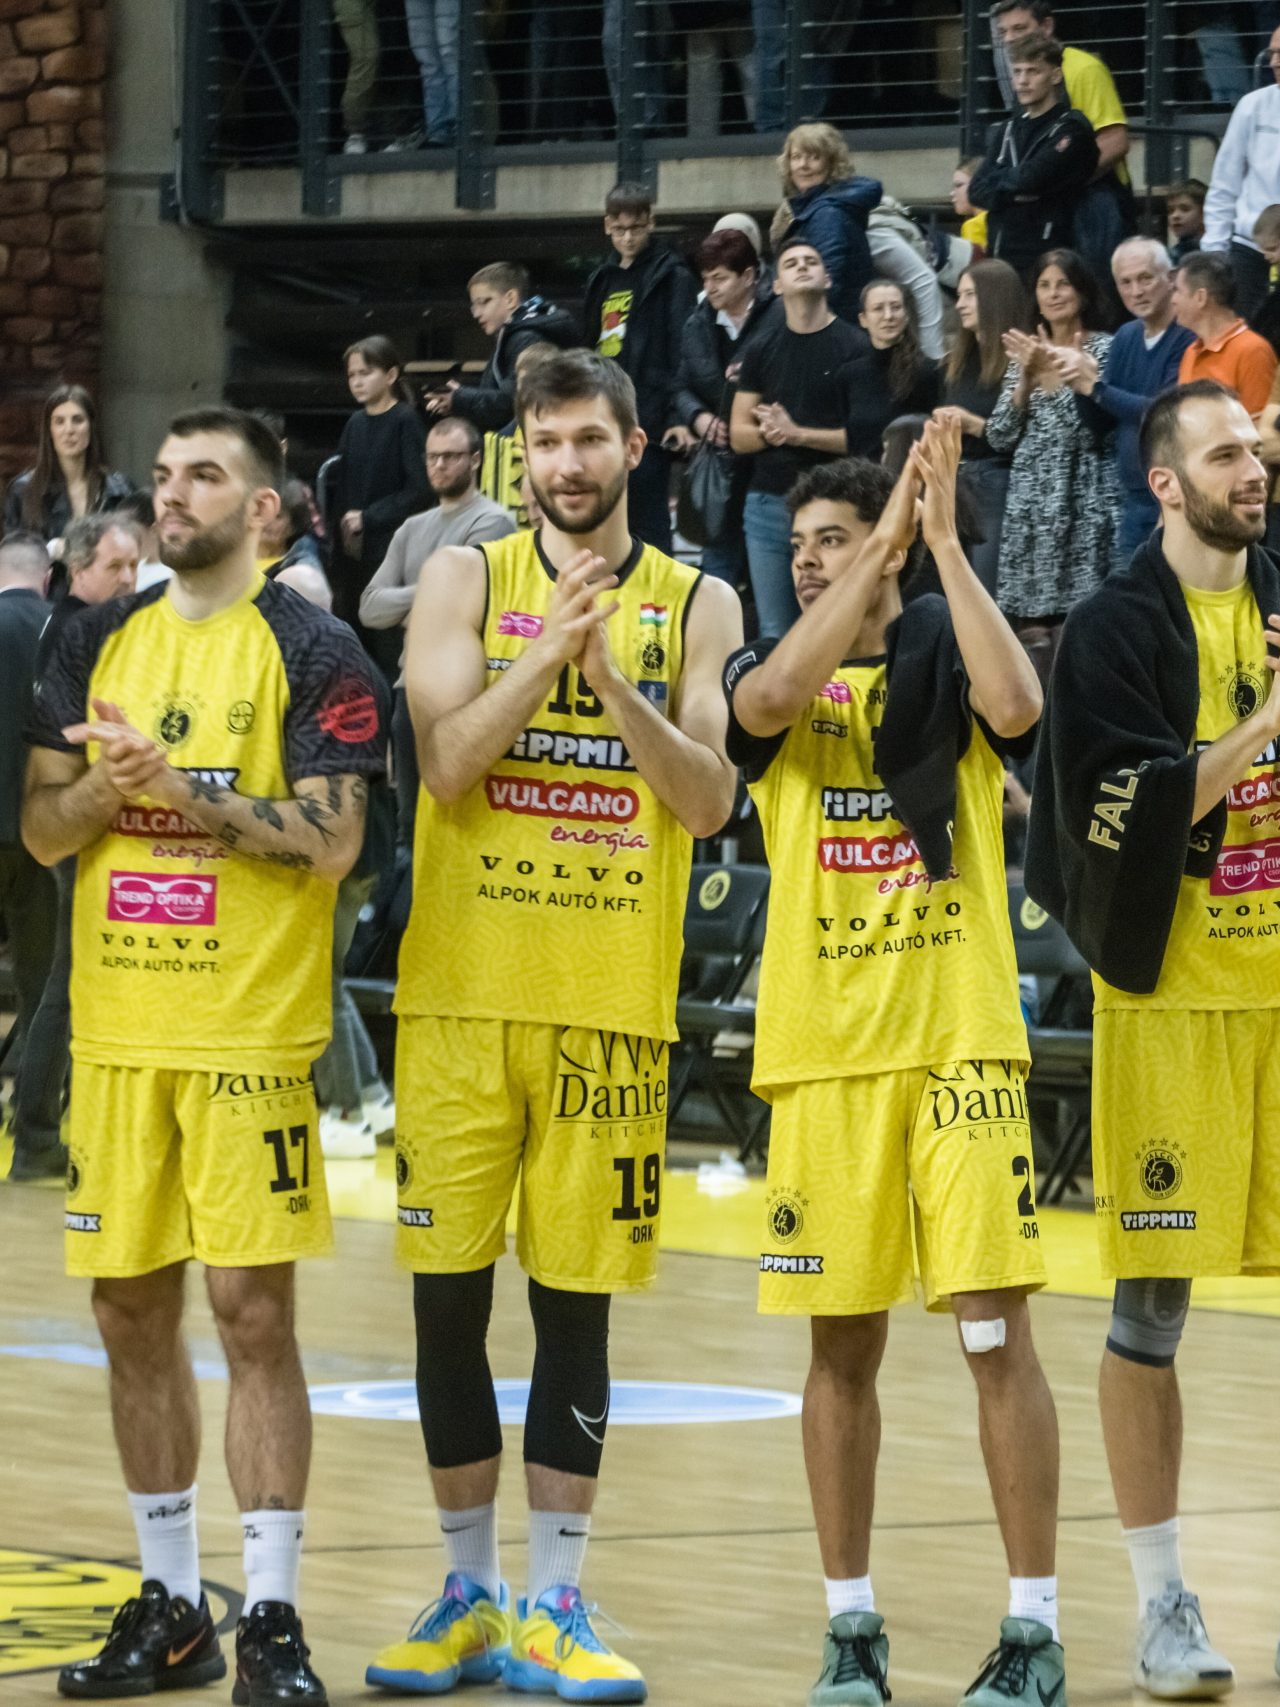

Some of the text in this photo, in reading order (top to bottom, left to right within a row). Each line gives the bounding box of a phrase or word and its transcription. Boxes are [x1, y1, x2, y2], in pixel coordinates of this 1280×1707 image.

[490, 780, 634, 818] VULCANO
[550, 825, 650, 858] energia
[480, 855, 644, 885] VOLVO
[1218, 860, 1261, 878] TREND
[156, 892, 205, 907] OPTIKA
[477, 884, 643, 914] ALPOK AUTÓ KFT.
[817, 901, 961, 932] VOLVO
[102, 932, 219, 951] VOLVO
[817, 929, 966, 960] ALPOK AUTÓ KFT.
[1208, 926, 1254, 939] ALPOK
[144, 957, 184, 973] AUTÓ
[188, 961, 221, 974] KFT.
[929, 1078, 1030, 1132] Dani
[263, 1124, 309, 1193] 17
[612, 1152, 661, 1221] 19
